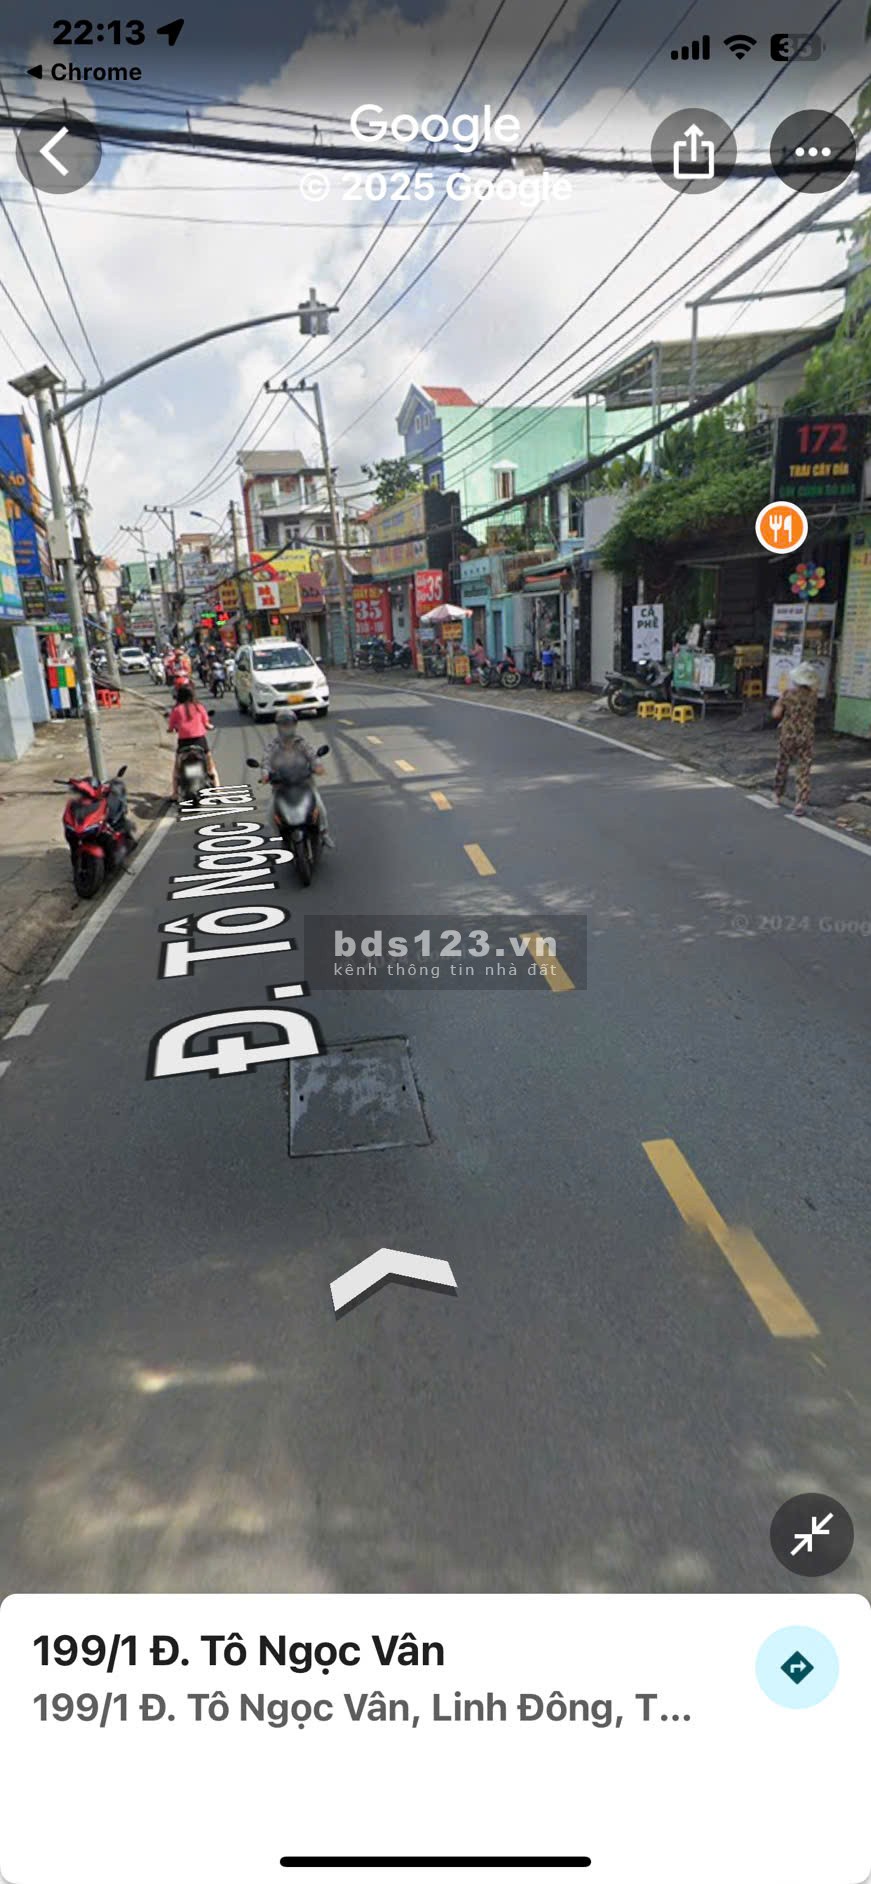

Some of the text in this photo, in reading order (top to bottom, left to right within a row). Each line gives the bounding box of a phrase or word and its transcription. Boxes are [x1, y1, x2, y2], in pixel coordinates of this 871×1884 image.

[798, 422, 848, 455] 172
[426, 575, 443, 601] 35
[355, 600, 382, 620] 35
